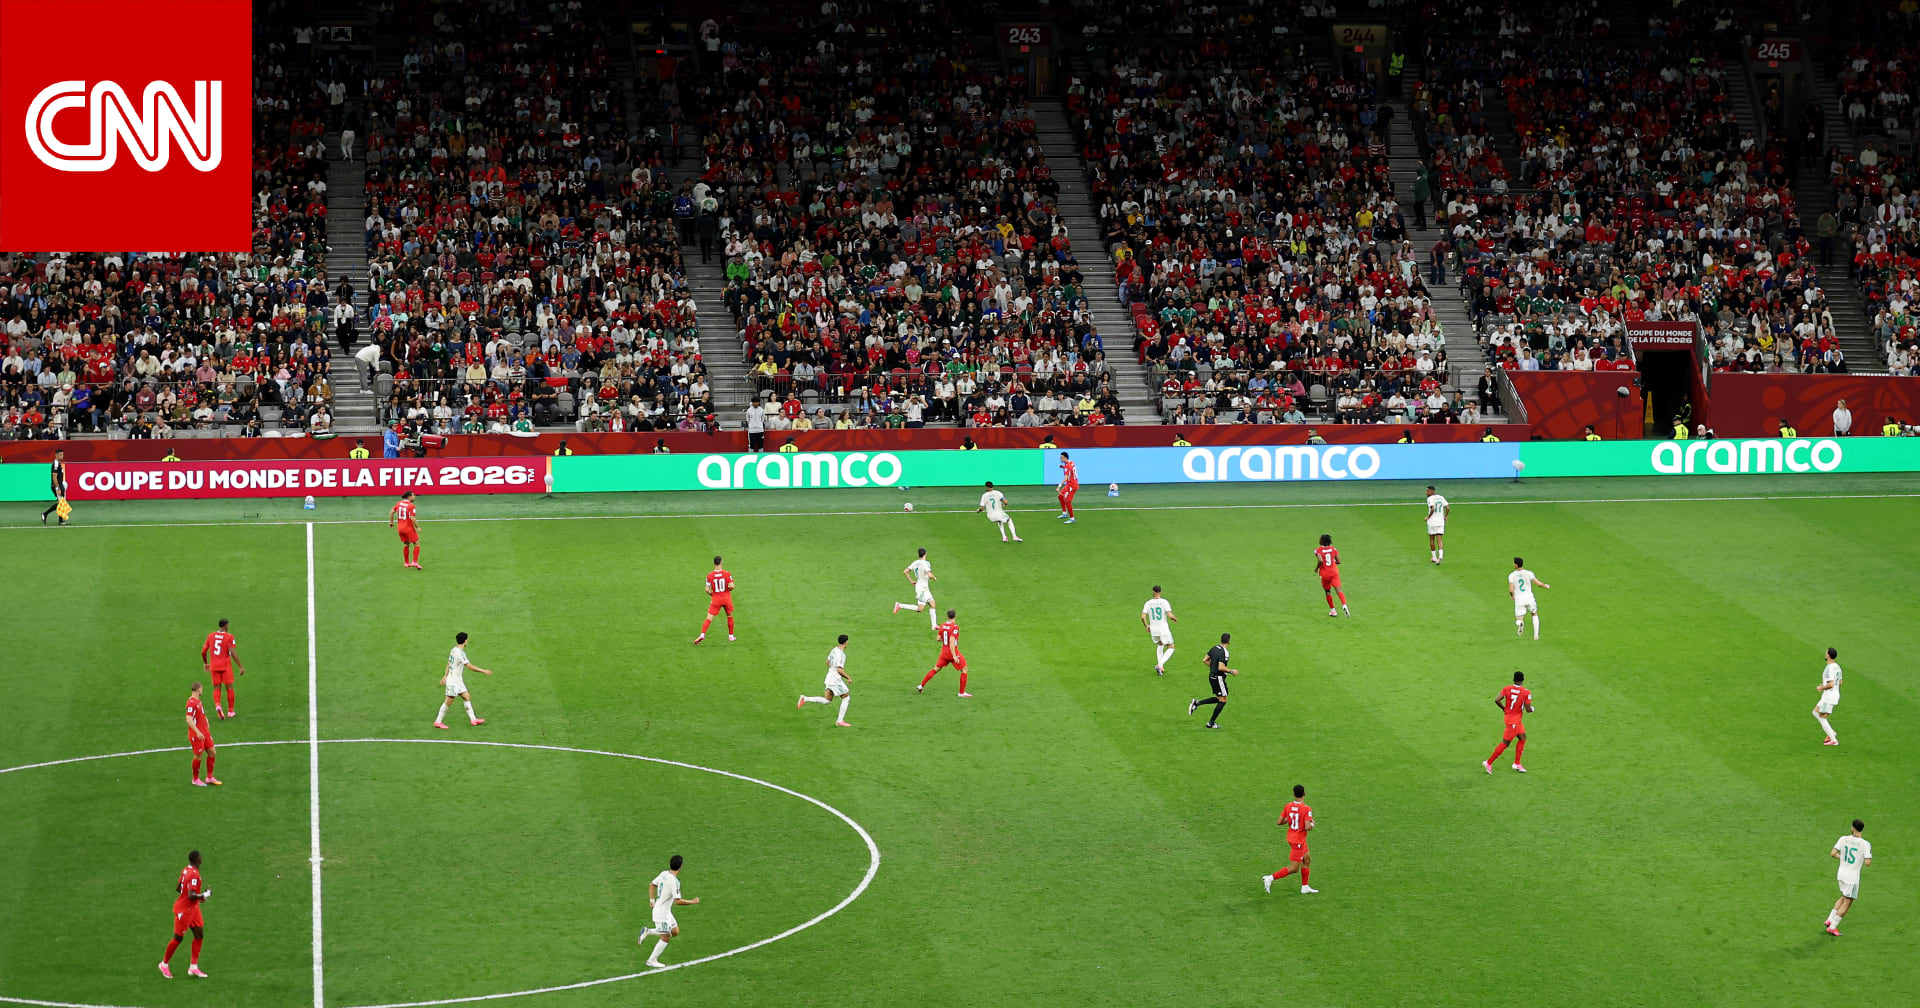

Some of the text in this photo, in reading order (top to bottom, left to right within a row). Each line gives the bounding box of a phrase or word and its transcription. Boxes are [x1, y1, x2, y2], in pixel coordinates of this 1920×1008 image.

[1009, 28, 1041, 43] 243
[1343, 28, 1376, 44] 244
[1757, 43, 1790, 59] 245
[1182, 445, 1381, 481] aramco
[1651, 439, 1843, 474] aramco
[78, 471, 163, 491] COUPE
[168, 470, 203, 490] DU
[209, 469, 300, 489] MONDE
[304, 468, 338, 488] DE
[342, 467, 375, 487] LA
[379, 467, 434, 487] FIFA
[439, 465, 527, 485] 2026
[697, 452, 902, 488] aramco
[989, 498, 996, 510] 7
[398, 507, 407, 520] 13
[1325, 554, 1332, 567] 9
[713, 578, 726, 593] 10
[1518, 579, 1526, 592] 2
[1150, 607, 1162, 621] 19
[214, 640, 223, 655] 5
[1510, 694, 1519, 710] 7
[1289, 812, 1300, 830] 11
[1844, 845, 1858, 865] 15
